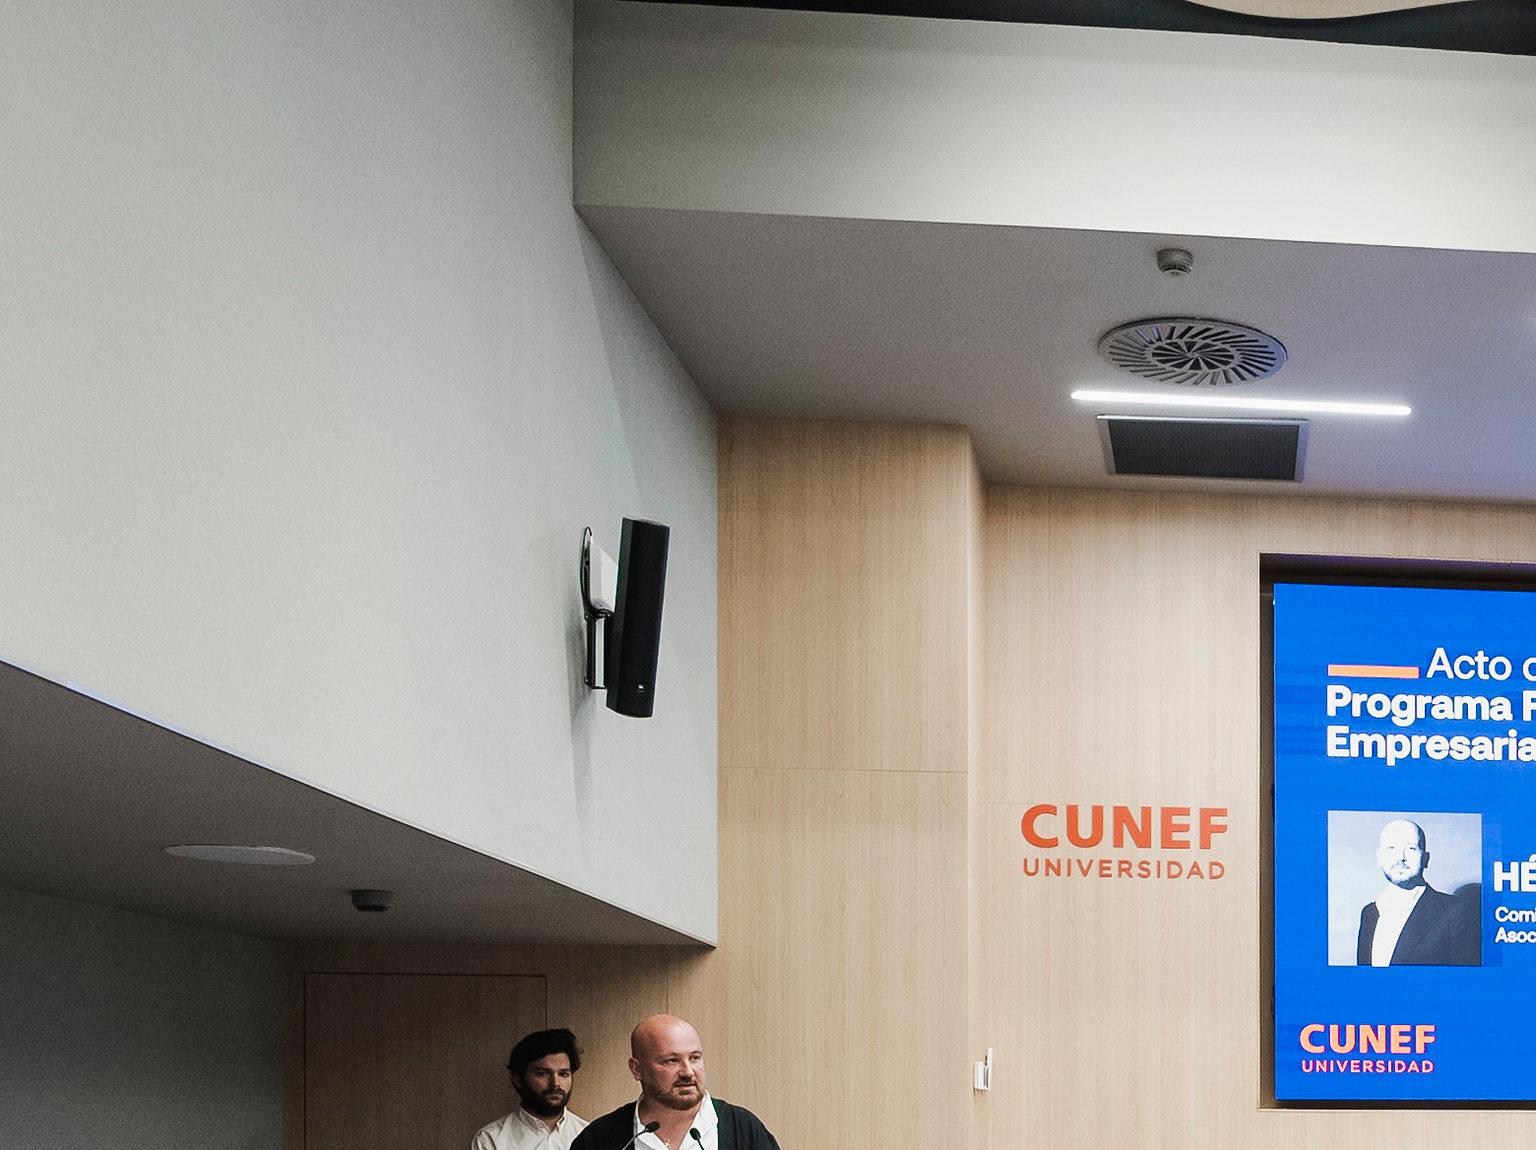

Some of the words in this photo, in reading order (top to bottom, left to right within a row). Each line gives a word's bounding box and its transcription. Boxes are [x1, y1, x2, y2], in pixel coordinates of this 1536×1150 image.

[1426, 647, 1512, 681] Acto
[1326, 684, 1513, 727] Programa
[1020, 803, 1228, 850] CUNEF
[1022, 857, 1226, 880] UNIVERSIDAD
[1299, 1023, 1437, 1054] CUNEF
[1301, 1059, 1435, 1074] UNIVERSIDAD
